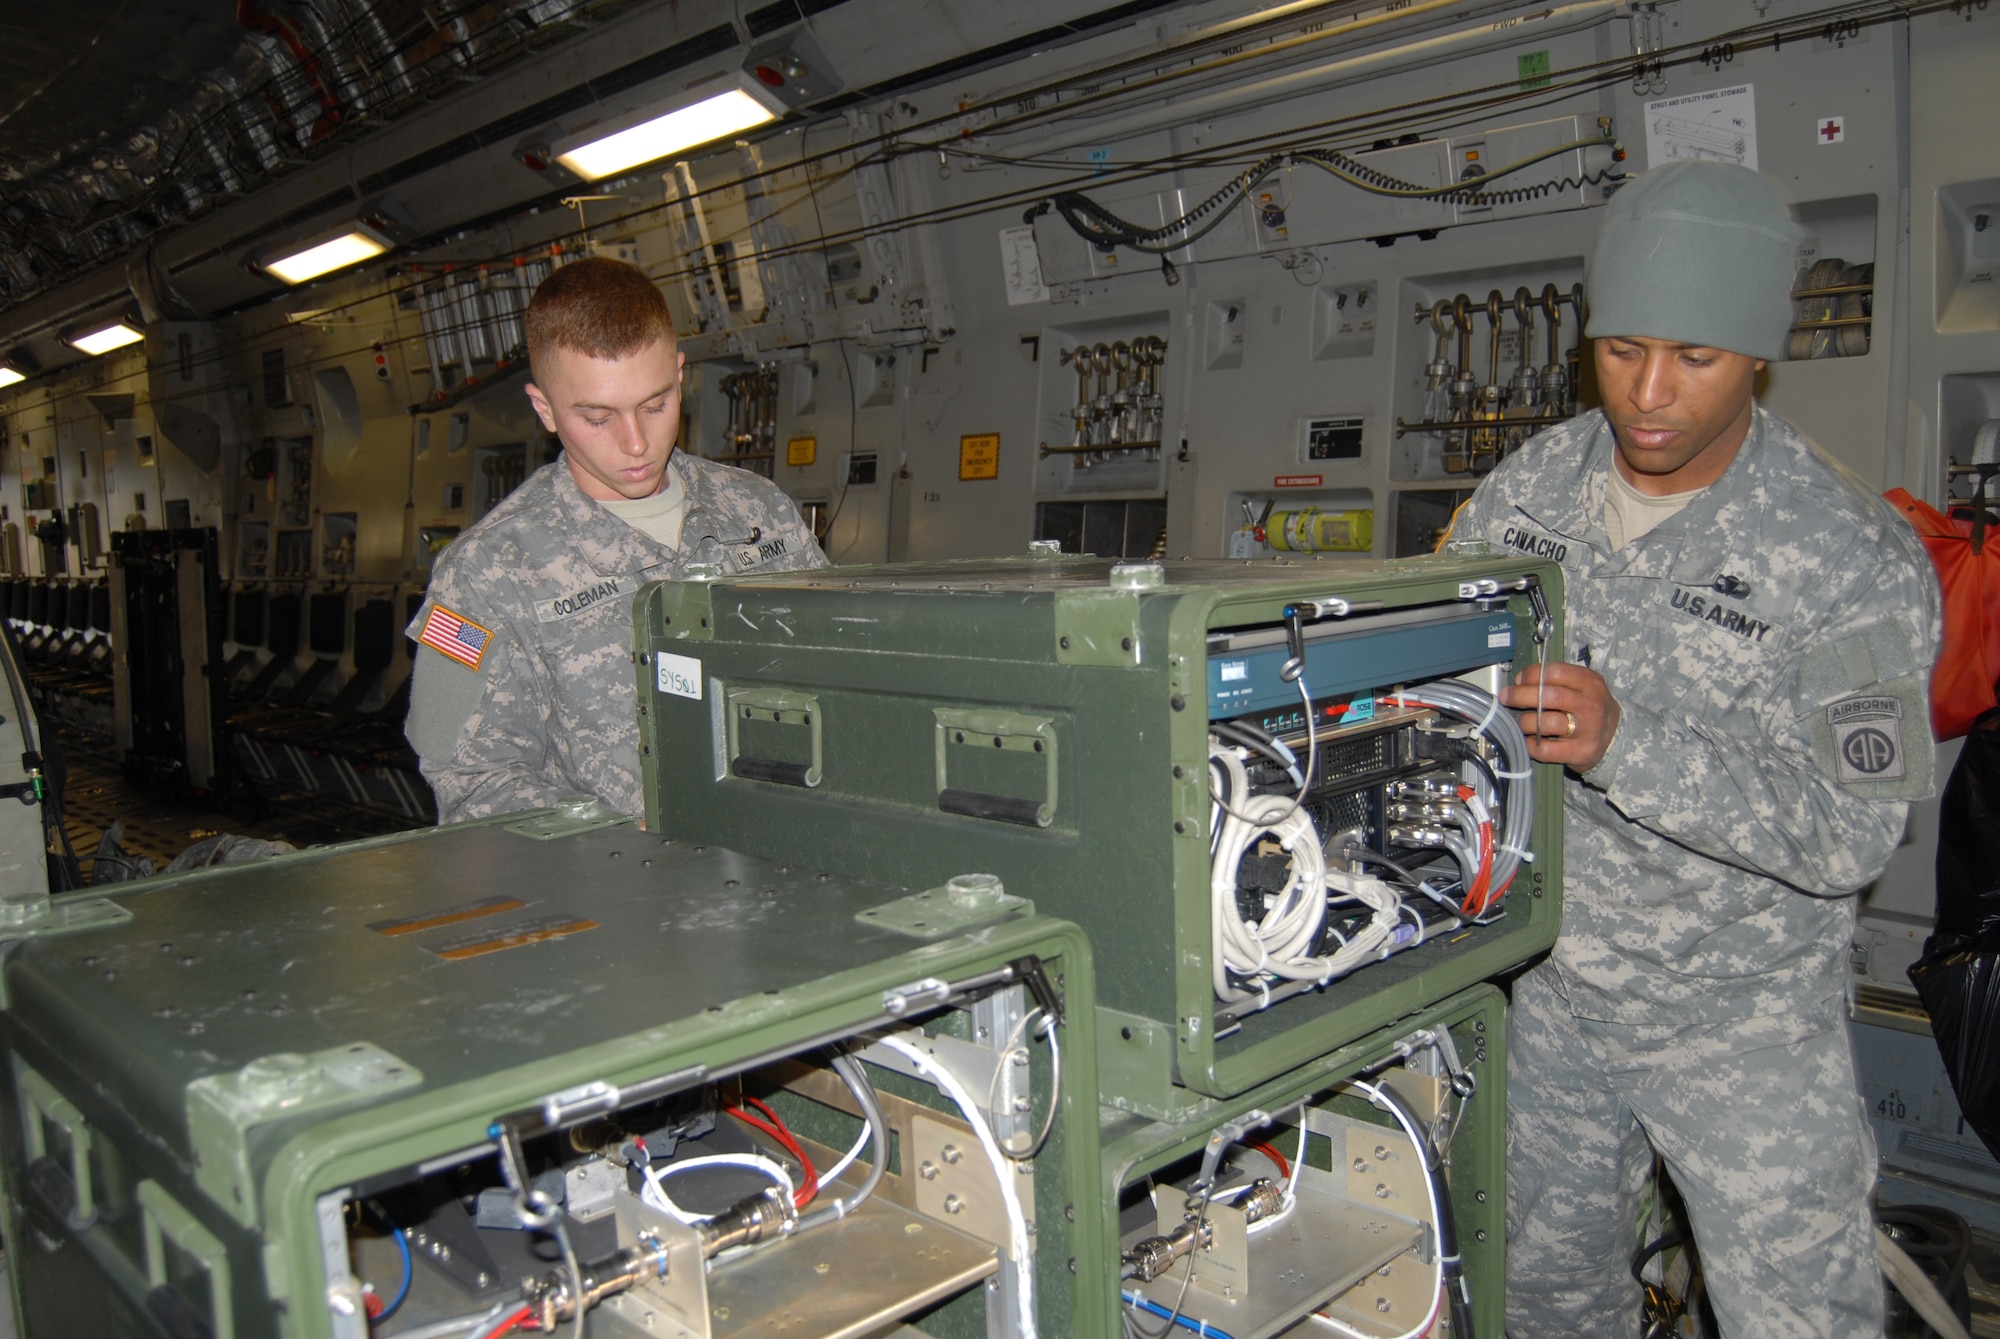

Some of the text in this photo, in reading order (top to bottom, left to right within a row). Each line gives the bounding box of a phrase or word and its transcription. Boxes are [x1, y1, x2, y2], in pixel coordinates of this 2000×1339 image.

[1493, 18, 1517, 31] FWD
[1650, 86, 1747, 110] STRUT AND UTILITY PANEL STOWAGE
[758, 537, 788, 560] ARMY
[553, 578, 620, 617] COLEMAN
[1356, 701, 1372, 712] ROSE
[1832, 700, 1897, 717] AIRBORNE
[1877, 1099, 1906, 1119] 410
